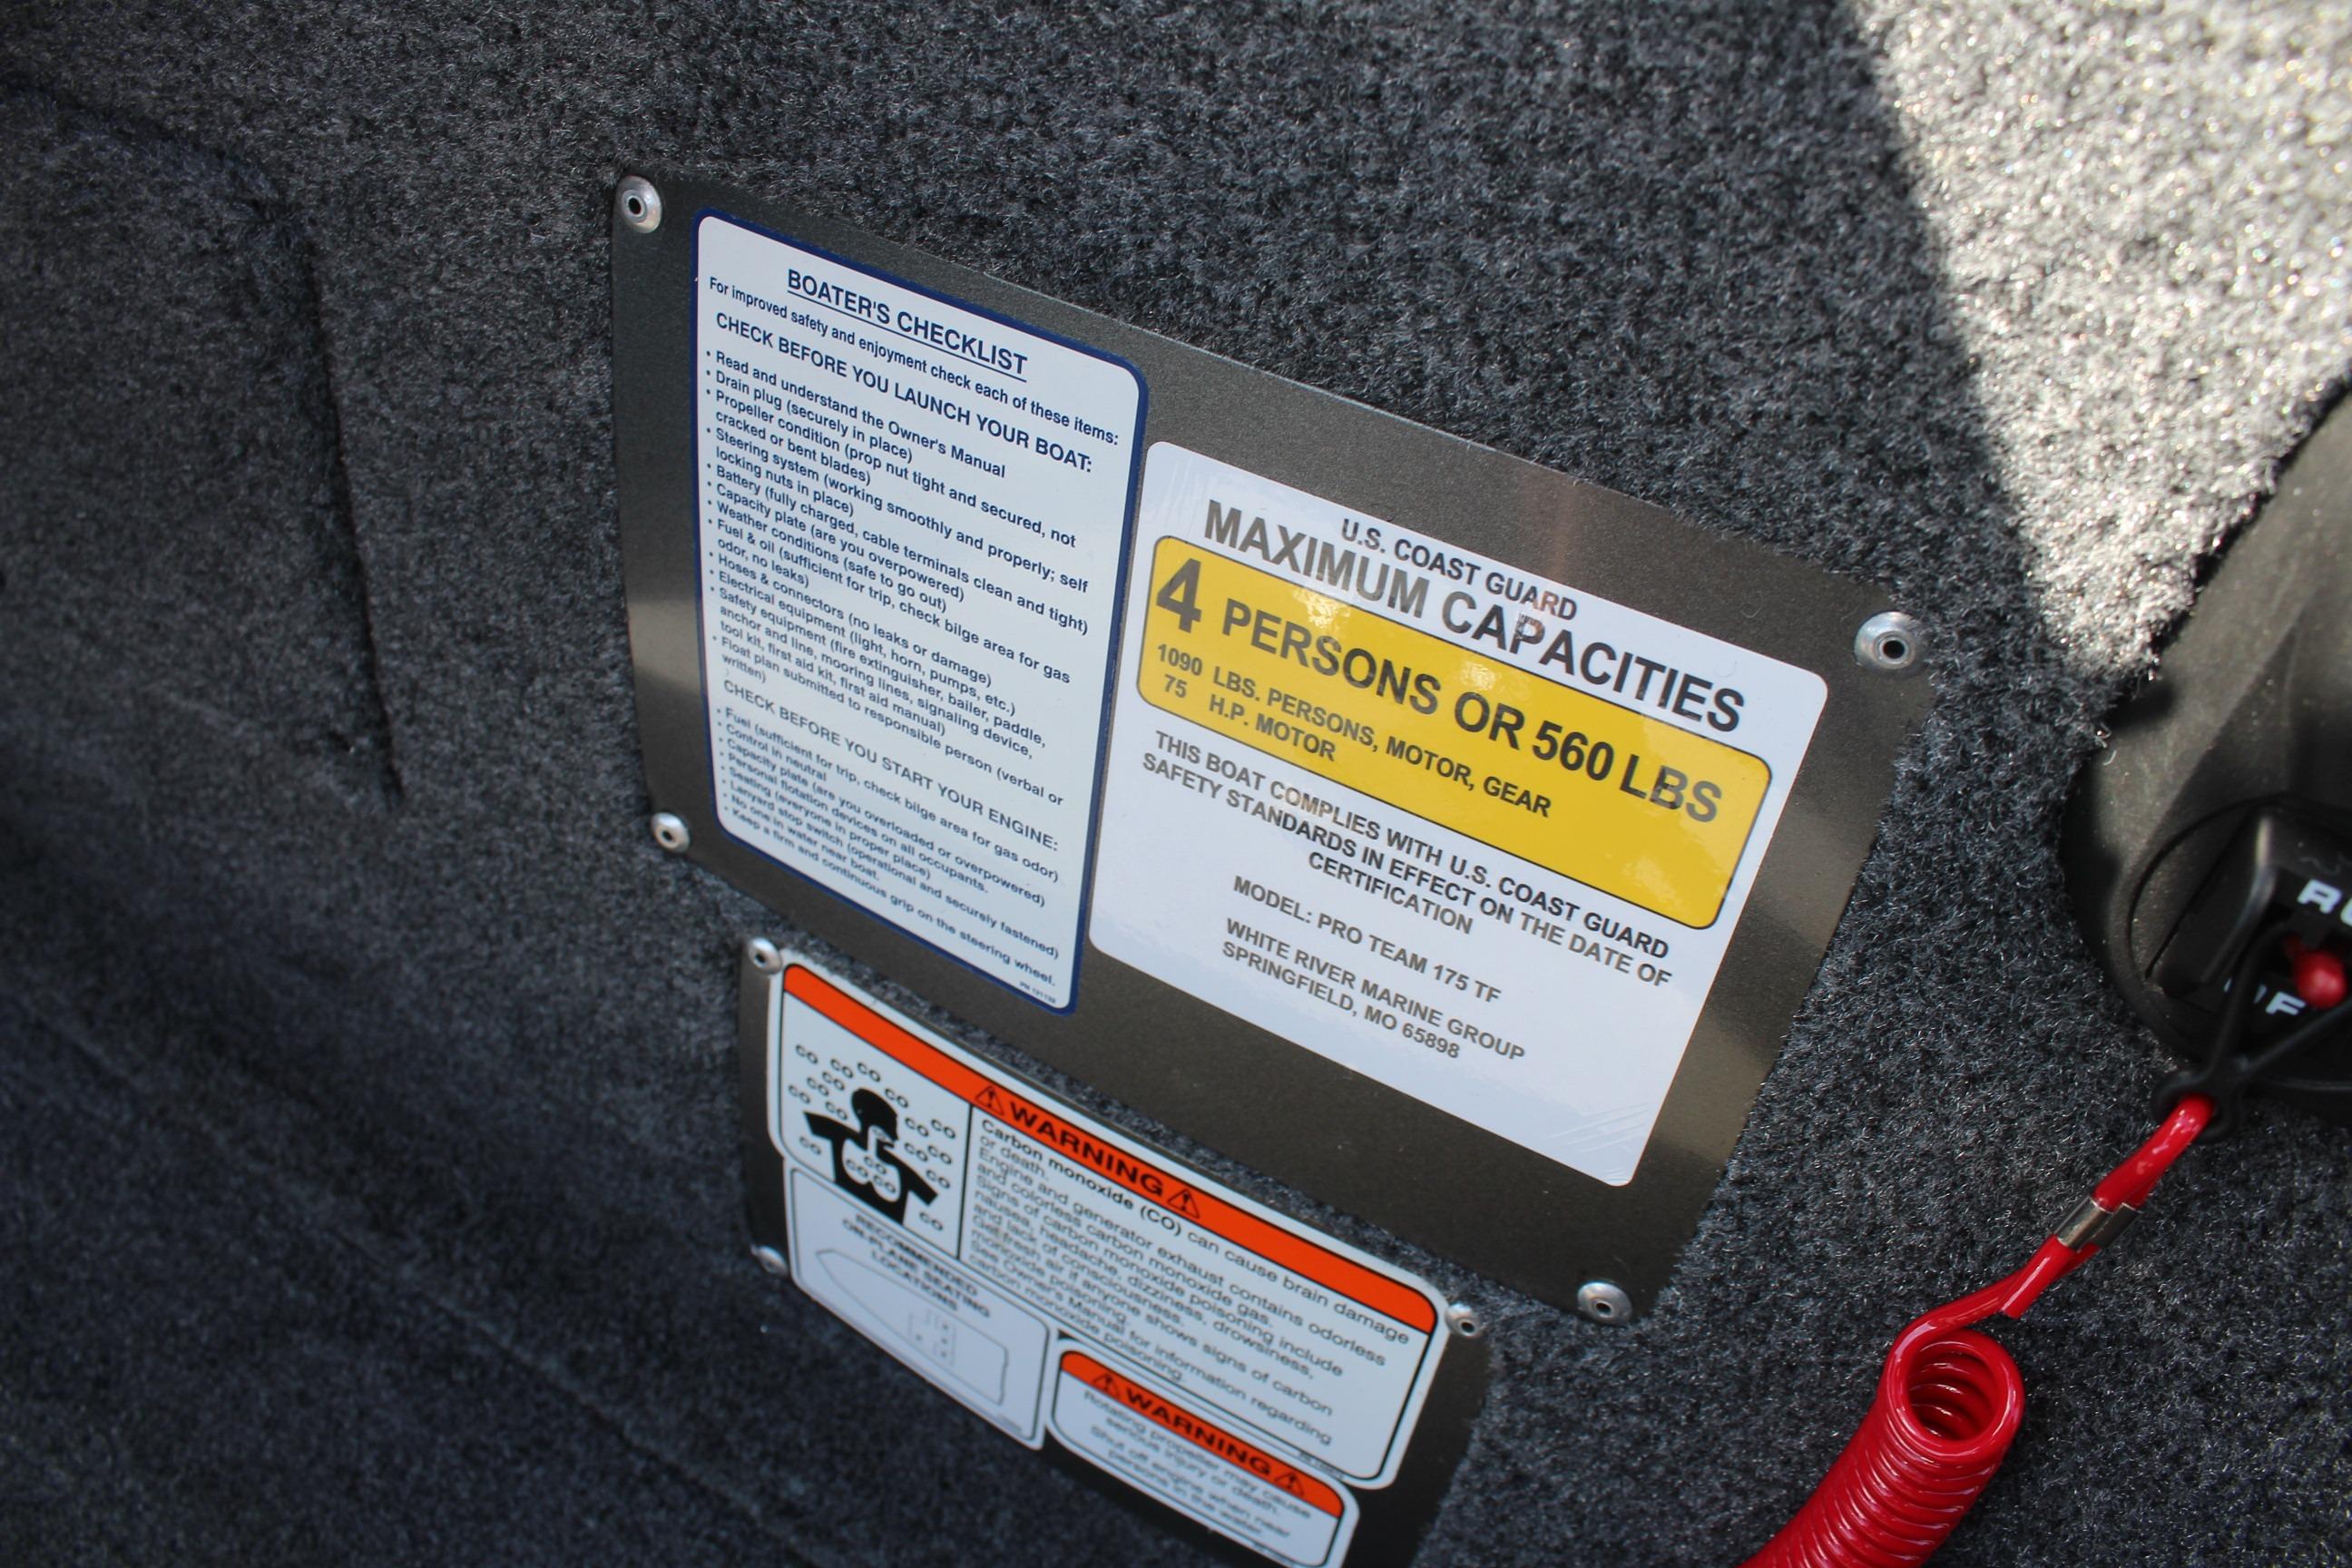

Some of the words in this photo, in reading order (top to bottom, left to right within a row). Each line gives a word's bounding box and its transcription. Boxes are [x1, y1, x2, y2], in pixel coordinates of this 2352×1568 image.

[710, 276, 729, 295] For
[731, 285, 788, 318] improved
[790, 311, 828, 338] safety
[831, 327, 855, 346] and
[858, 338, 927, 373] enjoyment
[930, 365, 971, 390] check
[975, 382, 1008, 404] each
[1012, 397, 1027, 410] of
[1030, 400, 1070, 427] these
[1073, 416, 1118, 446] items:
[788, 268, 890, 325] BOATER'S
[897, 310, 1028, 375] CHECKLIST
[716, 311, 773, 348] CHECK
[779, 336, 847, 377] BEFORE
[852, 365, 888, 393] YOU
[895, 382, 970, 426] LAUNCH
[975, 413, 1029, 448] YOUR
[1035, 436, 1092, 473] BOAT:
[716, 350, 749, 375] Read
[752, 368, 777, 386] and
[780, 379, 858, 419] understand
[861, 409, 884, 429] the
[887, 420, 946, 455] Owner's
[950, 445, 1005, 478] Manual
[716, 369, 750, 395] Drain
[753, 387, 782, 411] plug
[786, 399, 848, 437] (securely
[852, 426, 865, 442] in
[869, 436, 913, 464] place)
[715, 411, 766, 440] cracked
[769, 434, 784, 446] or
[787, 437, 817, 461] bent
[820, 452, 871, 486] blades)
[716, 388, 774, 424] Propeller
[778, 417, 839, 452] condition
[844, 443, 882, 470] (prop
[886, 462, 908, 480] nut
[912, 471, 945, 495] tight
[948, 488, 976, 507] and
[981, 501, 1045, 538] secured,
[1050, 529, 1075, 548] not
[716, 446, 761, 478] locking
[765, 469, 793, 489] nuts
[797, 480, 808, 496] in
[813, 490, 854, 517] place)
[716, 426, 769, 463] Steering
[772, 454, 819, 482] system
[824, 473, 883, 511] (working
[887, 502, 952, 539] smoothly
[956, 531, 984, 550] and
[987, 544, 1054, 582] properly;
[1060, 573, 1088, 593] self
[716, 464, 760, 495] Battery
[765, 485, 797, 511] (fully
[799, 504, 858, 537] charged,
[862, 530, 899, 554] cable
[903, 545, 969, 583] terminals
[973, 577, 1013, 602] clean
[1016, 595, 1044, 615] and
[1049, 607, 1088, 636] tight)
[1204, 499, 1430, 619] MAXIMUM
[1441, 591, 1744, 732] CAPACITIES
[1341, 518, 1385, 554] U.S.
[1394, 538, 1481, 585] COAST
[1485, 572, 1577, 621] GUARD
[1155, 557, 1202, 633] 4
[1221, 597, 1441, 715] PERSONS
[1454, 691, 1525, 750] OR
[1532, 720, 1615, 781] 560
[1619, 753, 1722, 823] LBS
[1157, 642, 1203, 676] 1090
[1212, 665, 1260, 701] LBS.
[1267, 687, 1378, 752] PERSONS,
[1386, 735, 1475, 791] MOTOR,
[1483, 776, 1552, 818] GEAR
[1164, 673, 1187, 699] 75
[1209, 693, 1249, 726] H.P.
[1255, 712, 1336, 761] MOTOR
[723, 679, 774, 713] CHECK
[779, 706, 840, 746] BEFORE
[845, 738, 877, 763] YOU
[882, 756, 933, 789] START
[937, 783, 984, 815] YOUR
[988, 808, 1058, 851] ENGINE:
[725, 706, 750, 729] Fuel
[754, 723, 812, 760] (sufficient
[816, 753, 833, 769] for
[863, 779, 900, 804] check
[905, 798, 936, 821] bilge
[939, 818, 968, 838] area
[972, 831, 991, 848] for
[994, 844, 1018, 862] gas
[1022, 858, 1058, 883] odor)
[1142, 752, 1223, 799] SAFETY
[1226, 789, 1357, 858] STANDARDS
[1361, 846, 1385, 870] IN
[1388, 858, 1476, 906] EFFECT
[1479, 897, 1514, 924] ON
[1520, 911, 1565, 946] THE
[1568, 933, 1633, 974] DATE
[1637, 963, 1672, 986] OF
[1155, 730, 1200, 764] THIS
[1205, 752, 1266, 790] BOAT
[1269, 780, 1380, 840] COMPLIES
[1387, 828, 1443, 867] WITH
[1449, 855, 1491, 888] U.S.
[1498, 876, 1580, 921] COAST
[1583, 911, 1669, 958] GUARD
[1308, 851, 1474, 935] CERTIFICATION
[1227, 917, 1290, 959] WHITE
[1294, 948, 1356, 989] RIVER
[1360, 978, 1443, 1027] MARINE
[1446, 1018, 1525, 1060] GROUP
[1233, 875, 1312, 924] MODEL:
[1317, 912, 1363, 945] PRO
[1368, 934, 1428, 974] TEAM
[1433, 964, 1469, 991] 175
[1475, 980, 1502, 1002] TF
[1222, 940, 1357, 1017] SPRINGFIELD,
[1364, 1004, 1397, 1030] MO
[1402, 1022, 1460, 1058] 65898
[796, 1045, 818, 1063] CO
[822, 1072, 845, 1091] CO
[831, 1059, 853, 1078] CO
[858, 1063, 880, 1082] CO
[885, 1089, 908, 1108] CO
[905, 1118, 928, 1137] CO
[926, 1170, 950, 1189] CO
[931, 1119, 956, 1139] CO
[1010, 1102, 1163, 1197] WARNING
[872, 1250, 957, 1311] LOCATIONS
[981, 1119, 1043, 1161] Carbon
[1048, 1158, 1133, 1210] monoxide
[1140, 1205, 1181, 1236] (CO)
[1188, 1231, 1220, 1253] can
[1224, 1250, 1278, 1282] cause
[1282, 1276, 1328, 1306] brain
[1333, 1303, 1409, 1344] damage
[924, 1269, 989, 1318] SEATING
[1126, 1388, 1271, 1475] WARNING
